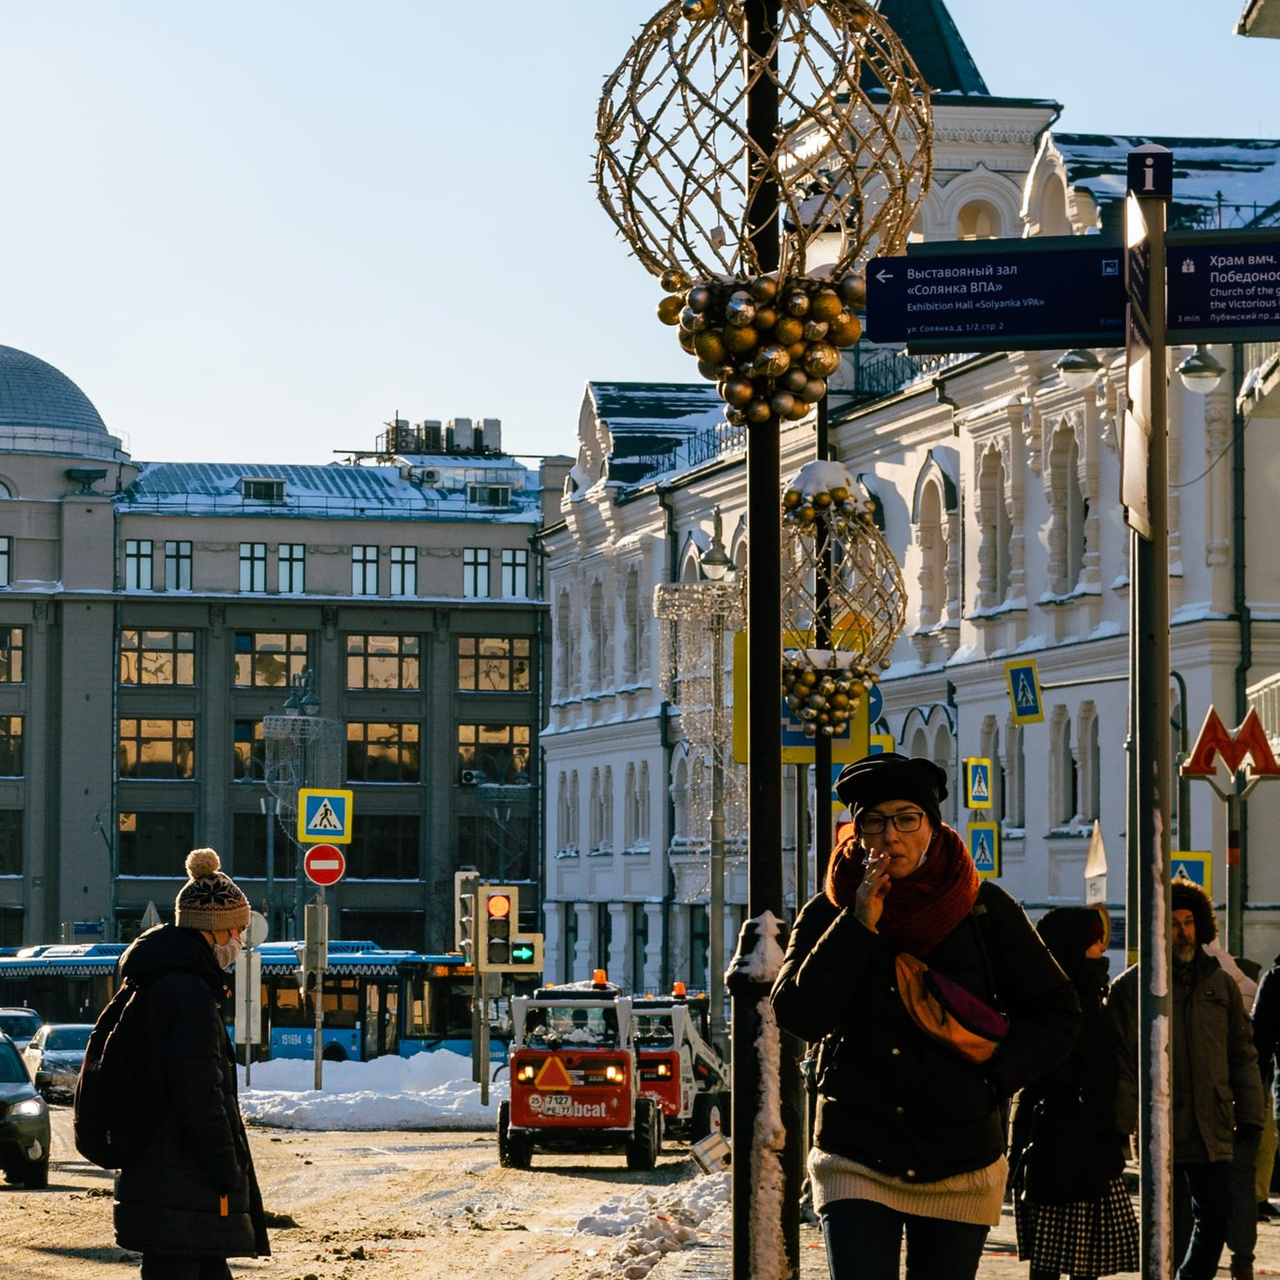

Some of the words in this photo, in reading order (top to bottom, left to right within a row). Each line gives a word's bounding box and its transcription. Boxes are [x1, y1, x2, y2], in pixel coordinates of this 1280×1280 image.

[1209, 255, 1245, 268] Храм
[1247, 254, 1278, 266] вмч.
[996, 265, 1018, 276] зал
[907, 283, 968, 296] «Солянка
[970, 281, 1003, 294] ВПА»
[1209, 287, 1244, 297] Church
[1245, 286, 1256, 296] of
[1257, 286, 1274, 296] the
[907, 301, 954, 312] Exhibition
[955, 300, 974, 310] Hall
[975, 298, 1021, 311] «Solyanka
[1022, 297, 1045, 307] VPA»
[1209, 300, 1227, 310] the
[1228, 299, 1277, 309] Victorious
[1183, 314, 1200, 323] min
[1209, 312, 1257, 323] Лубянский
[547, 1095, 569, 1105] 7127
